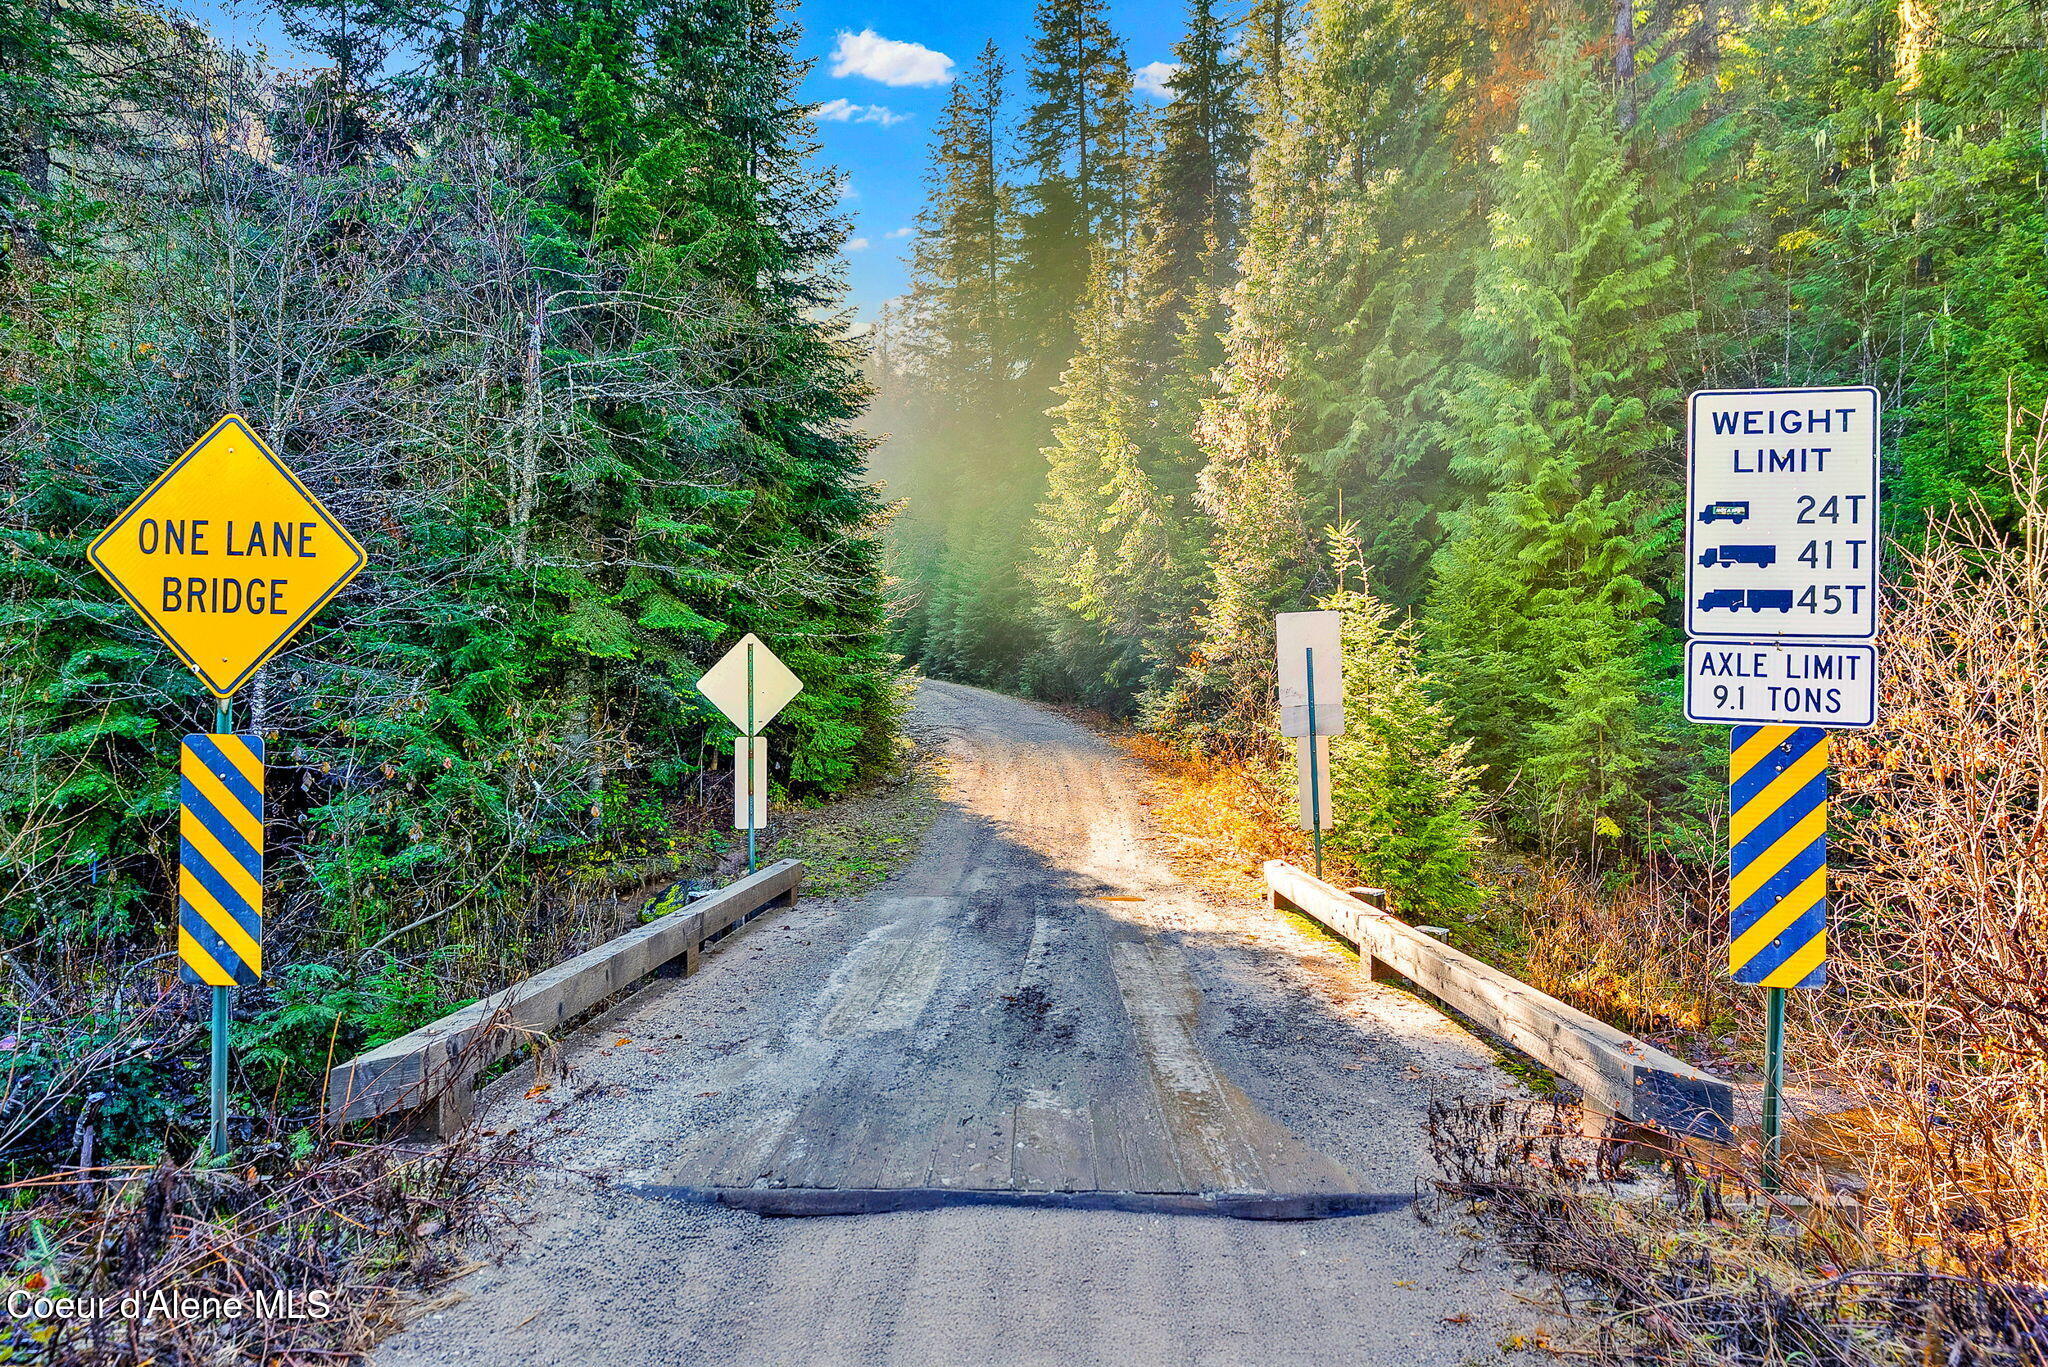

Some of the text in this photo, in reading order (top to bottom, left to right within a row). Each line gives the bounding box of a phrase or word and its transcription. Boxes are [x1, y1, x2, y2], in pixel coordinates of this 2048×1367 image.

[1712, 408, 1856, 435] WEIGHT
[1733, 448, 1831, 473] LIMIT
[138, 518, 317, 557] ONE LANE
[162, 577, 288, 614] BRIDGE
[1700, 652, 1861, 680] AXLE LIMIT
[1713, 686, 1842, 714] 9.1 TONS
